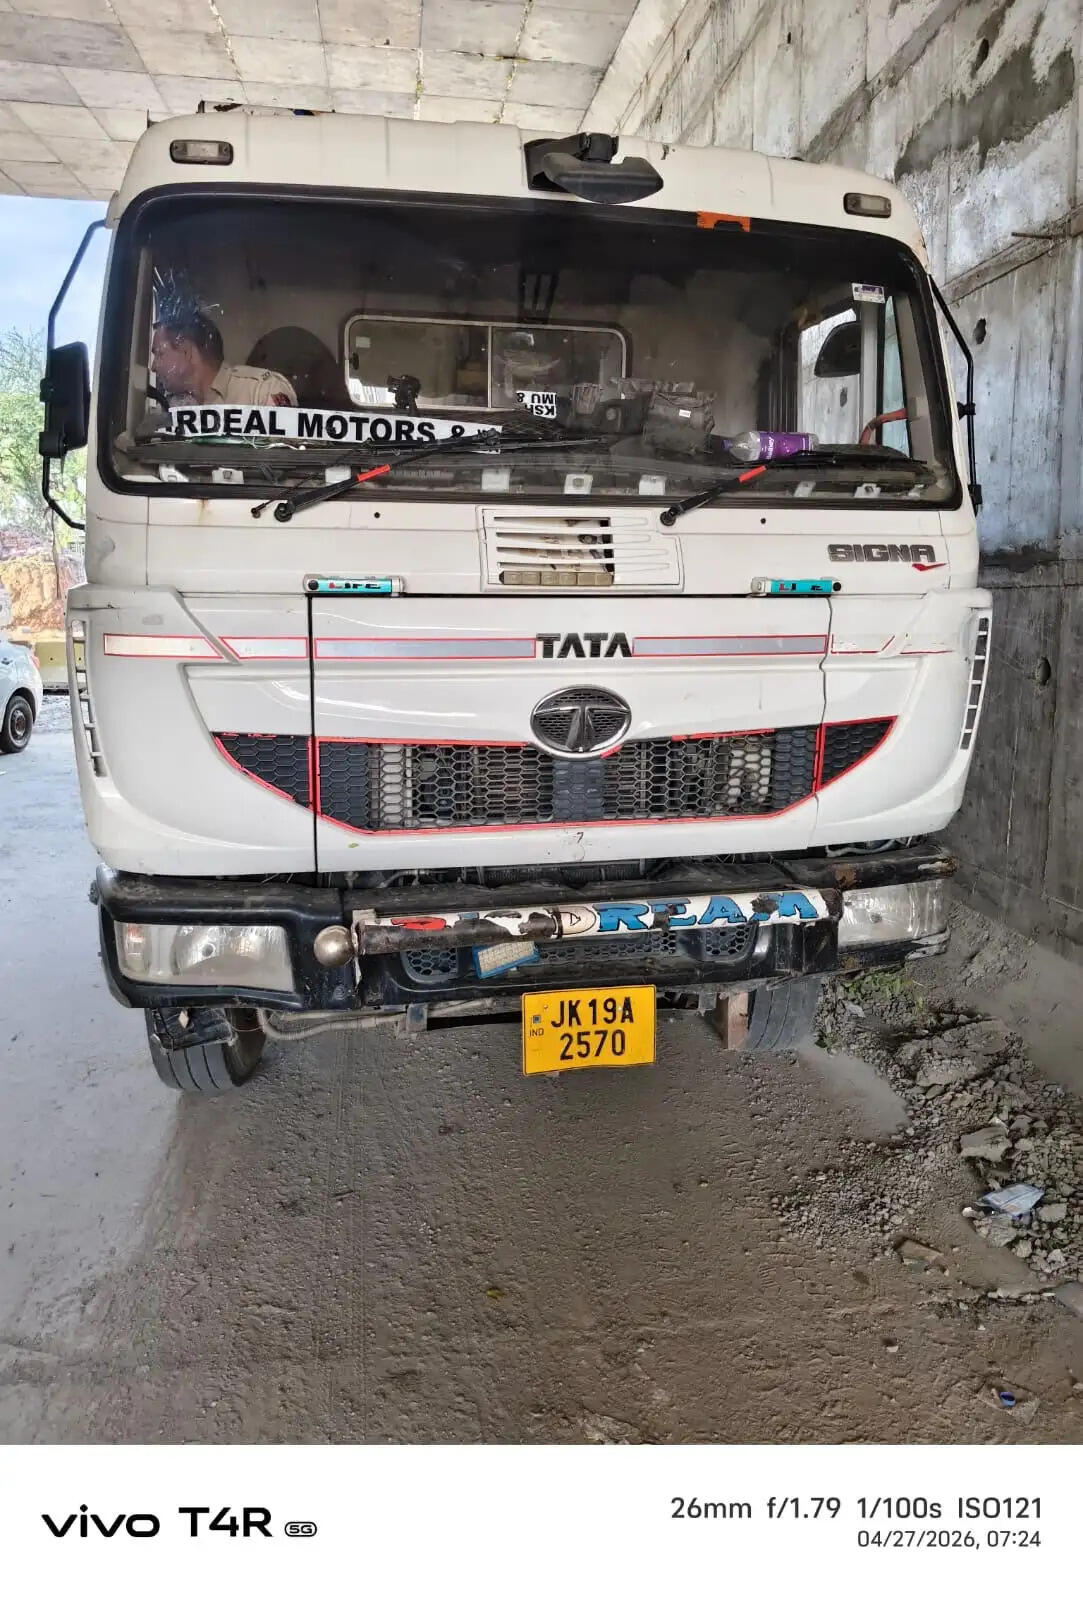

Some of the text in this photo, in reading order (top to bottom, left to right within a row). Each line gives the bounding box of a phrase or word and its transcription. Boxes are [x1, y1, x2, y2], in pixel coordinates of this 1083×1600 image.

[168, 409, 286, 438] RDEAL
[297, 412, 436, 442] MOTORS
[828, 544, 937, 563] SIGNA
[536, 632, 633, 659] TATA
[560, 1029, 625, 1061] 2570
